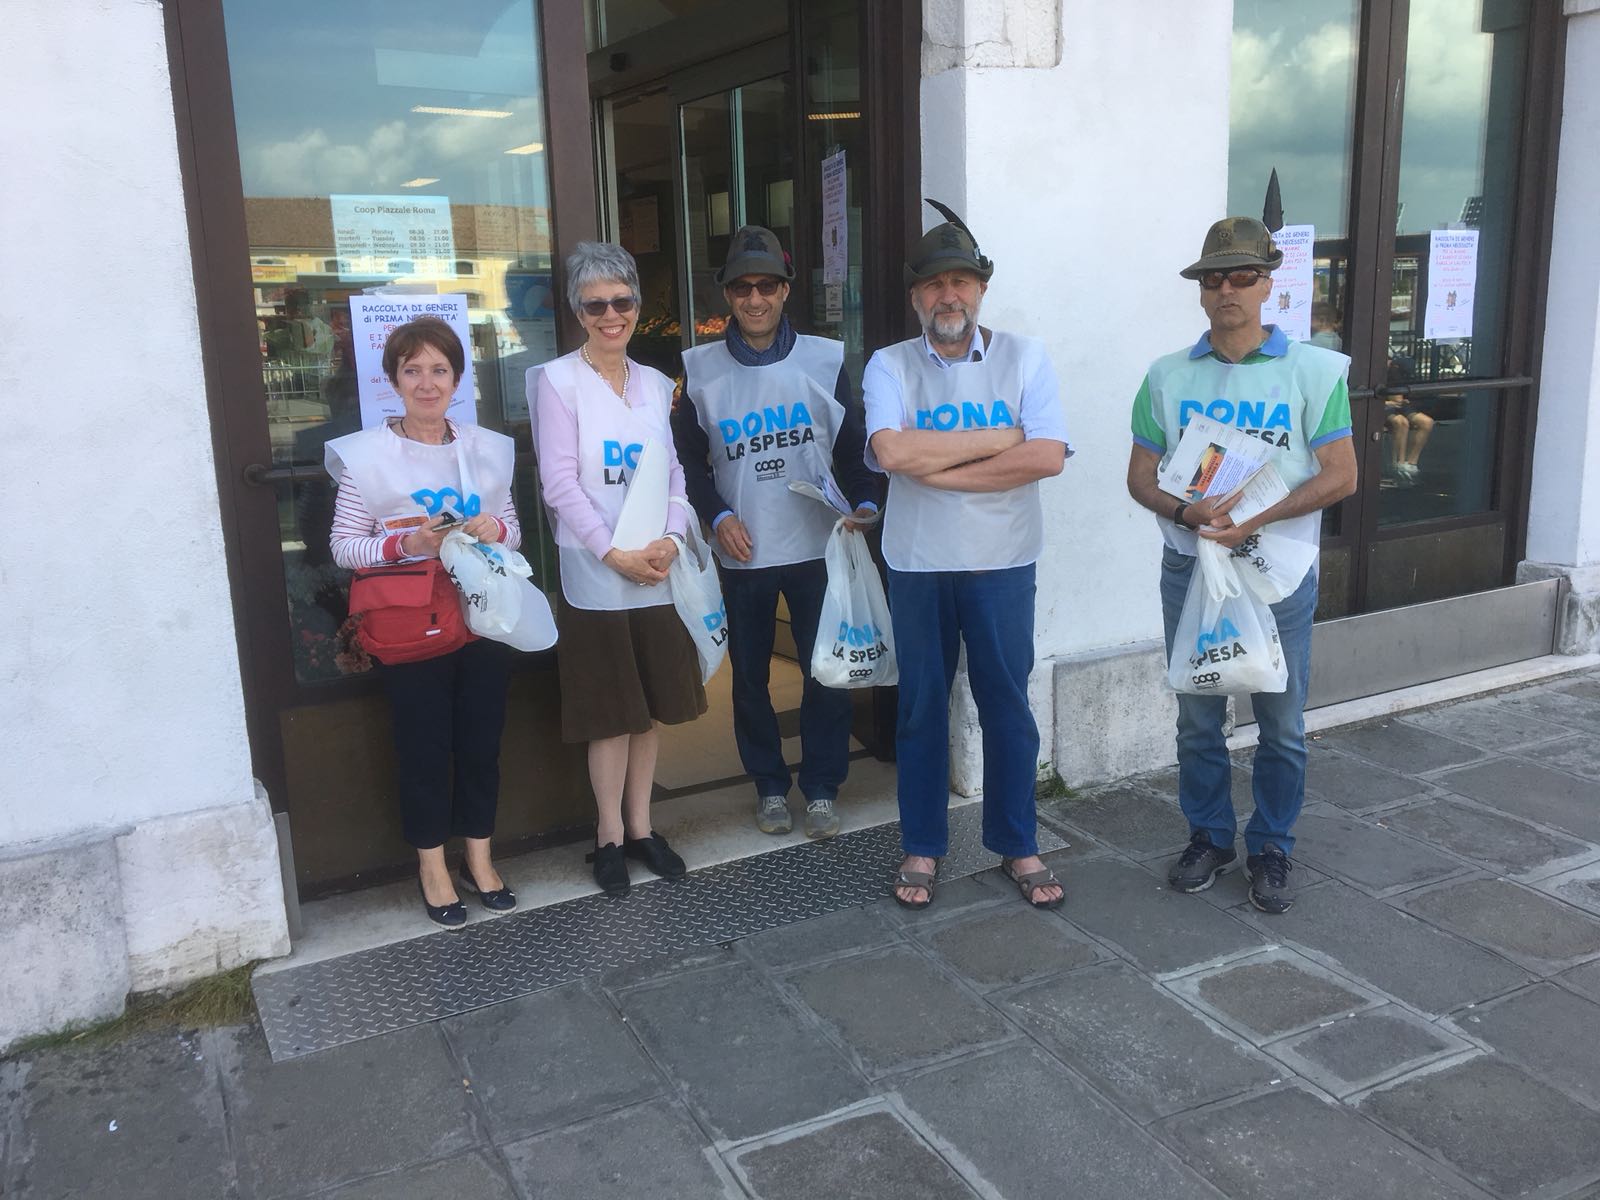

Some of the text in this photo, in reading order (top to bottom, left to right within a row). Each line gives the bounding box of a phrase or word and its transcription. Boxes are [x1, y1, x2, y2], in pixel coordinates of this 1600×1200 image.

[354, 205, 436, 214] Coop Piazzale Roma
[362, 303, 459, 313] RACCOLTA DI GENERI
[364, 315, 372, 323] di
[375, 313, 403, 323] PRIMA
[369, 333, 375, 341] E
[1179, 399, 1293, 431] DONA
[719, 401, 813, 444] DONA
[725, 427, 815, 461] LA SPESA
[603, 440, 643, 470] DO
[754, 458, 785, 472] coop
[603, 468, 628, 486] LA
[832, 641, 889, 663] LA SPESA
[849, 668, 873, 678] coop
[1192, 671, 1221, 685] coop
